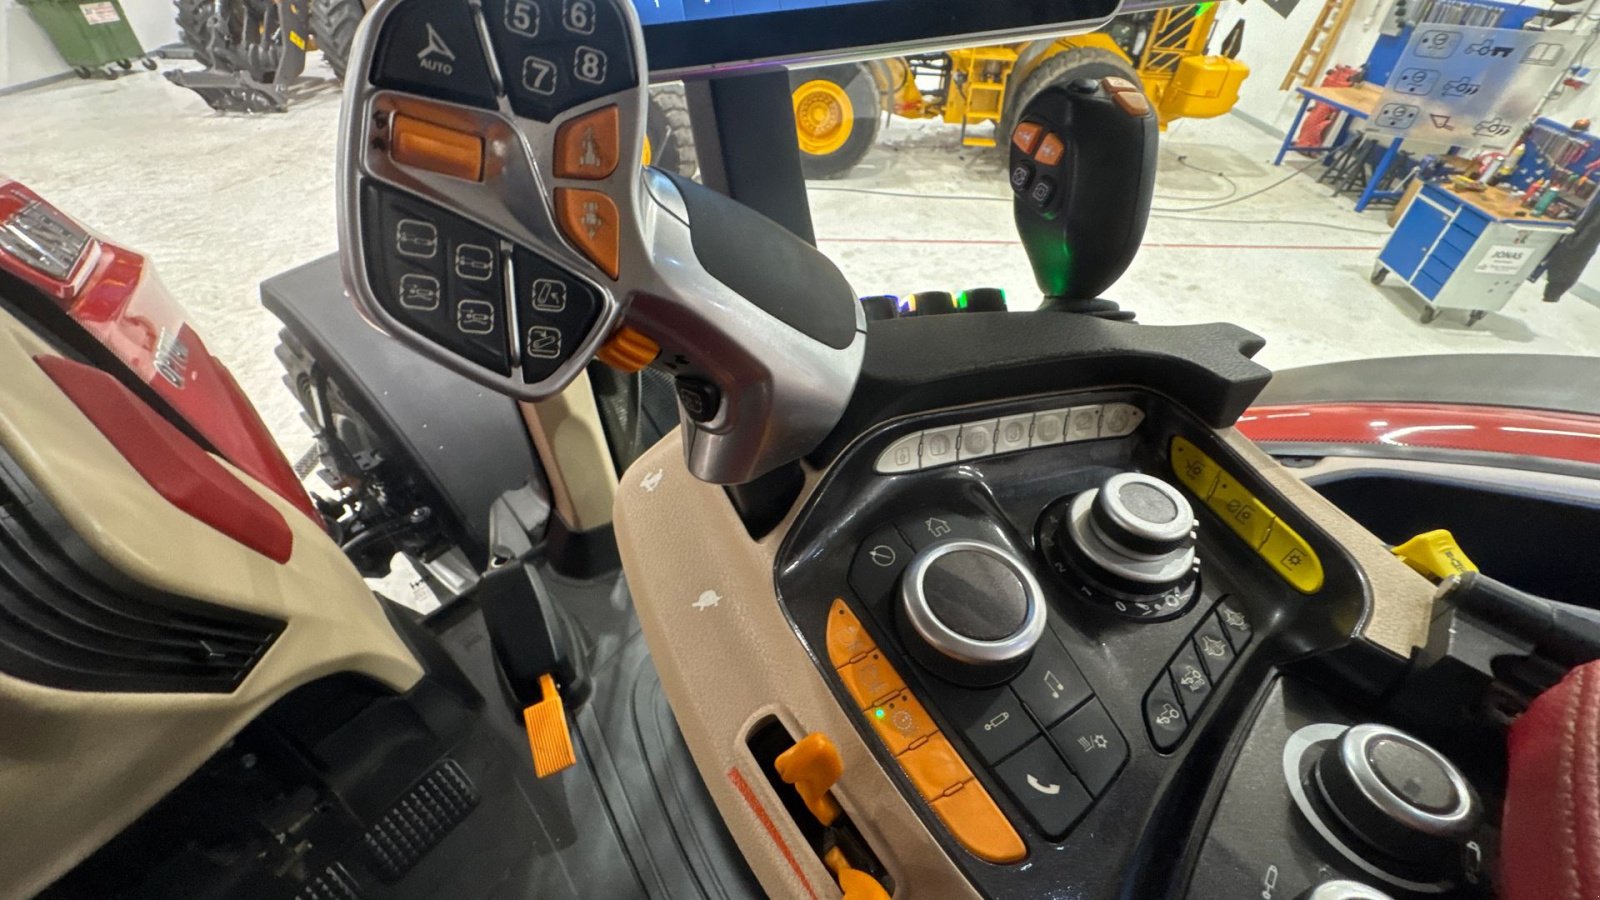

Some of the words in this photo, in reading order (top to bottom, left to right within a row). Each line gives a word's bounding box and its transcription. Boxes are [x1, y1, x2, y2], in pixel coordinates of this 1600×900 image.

[513, 2, 531, 30] 5
[570, 2, 588, 28] 6
[420, 58, 452, 75] AUTO
[531, 61, 550, 88] 7
[582, 52, 599, 79] 8
[1055, 562, 1067, 573] 2
[1081, 585, 1092, 597] 1
[1115, 601, 1127, 611] 0
